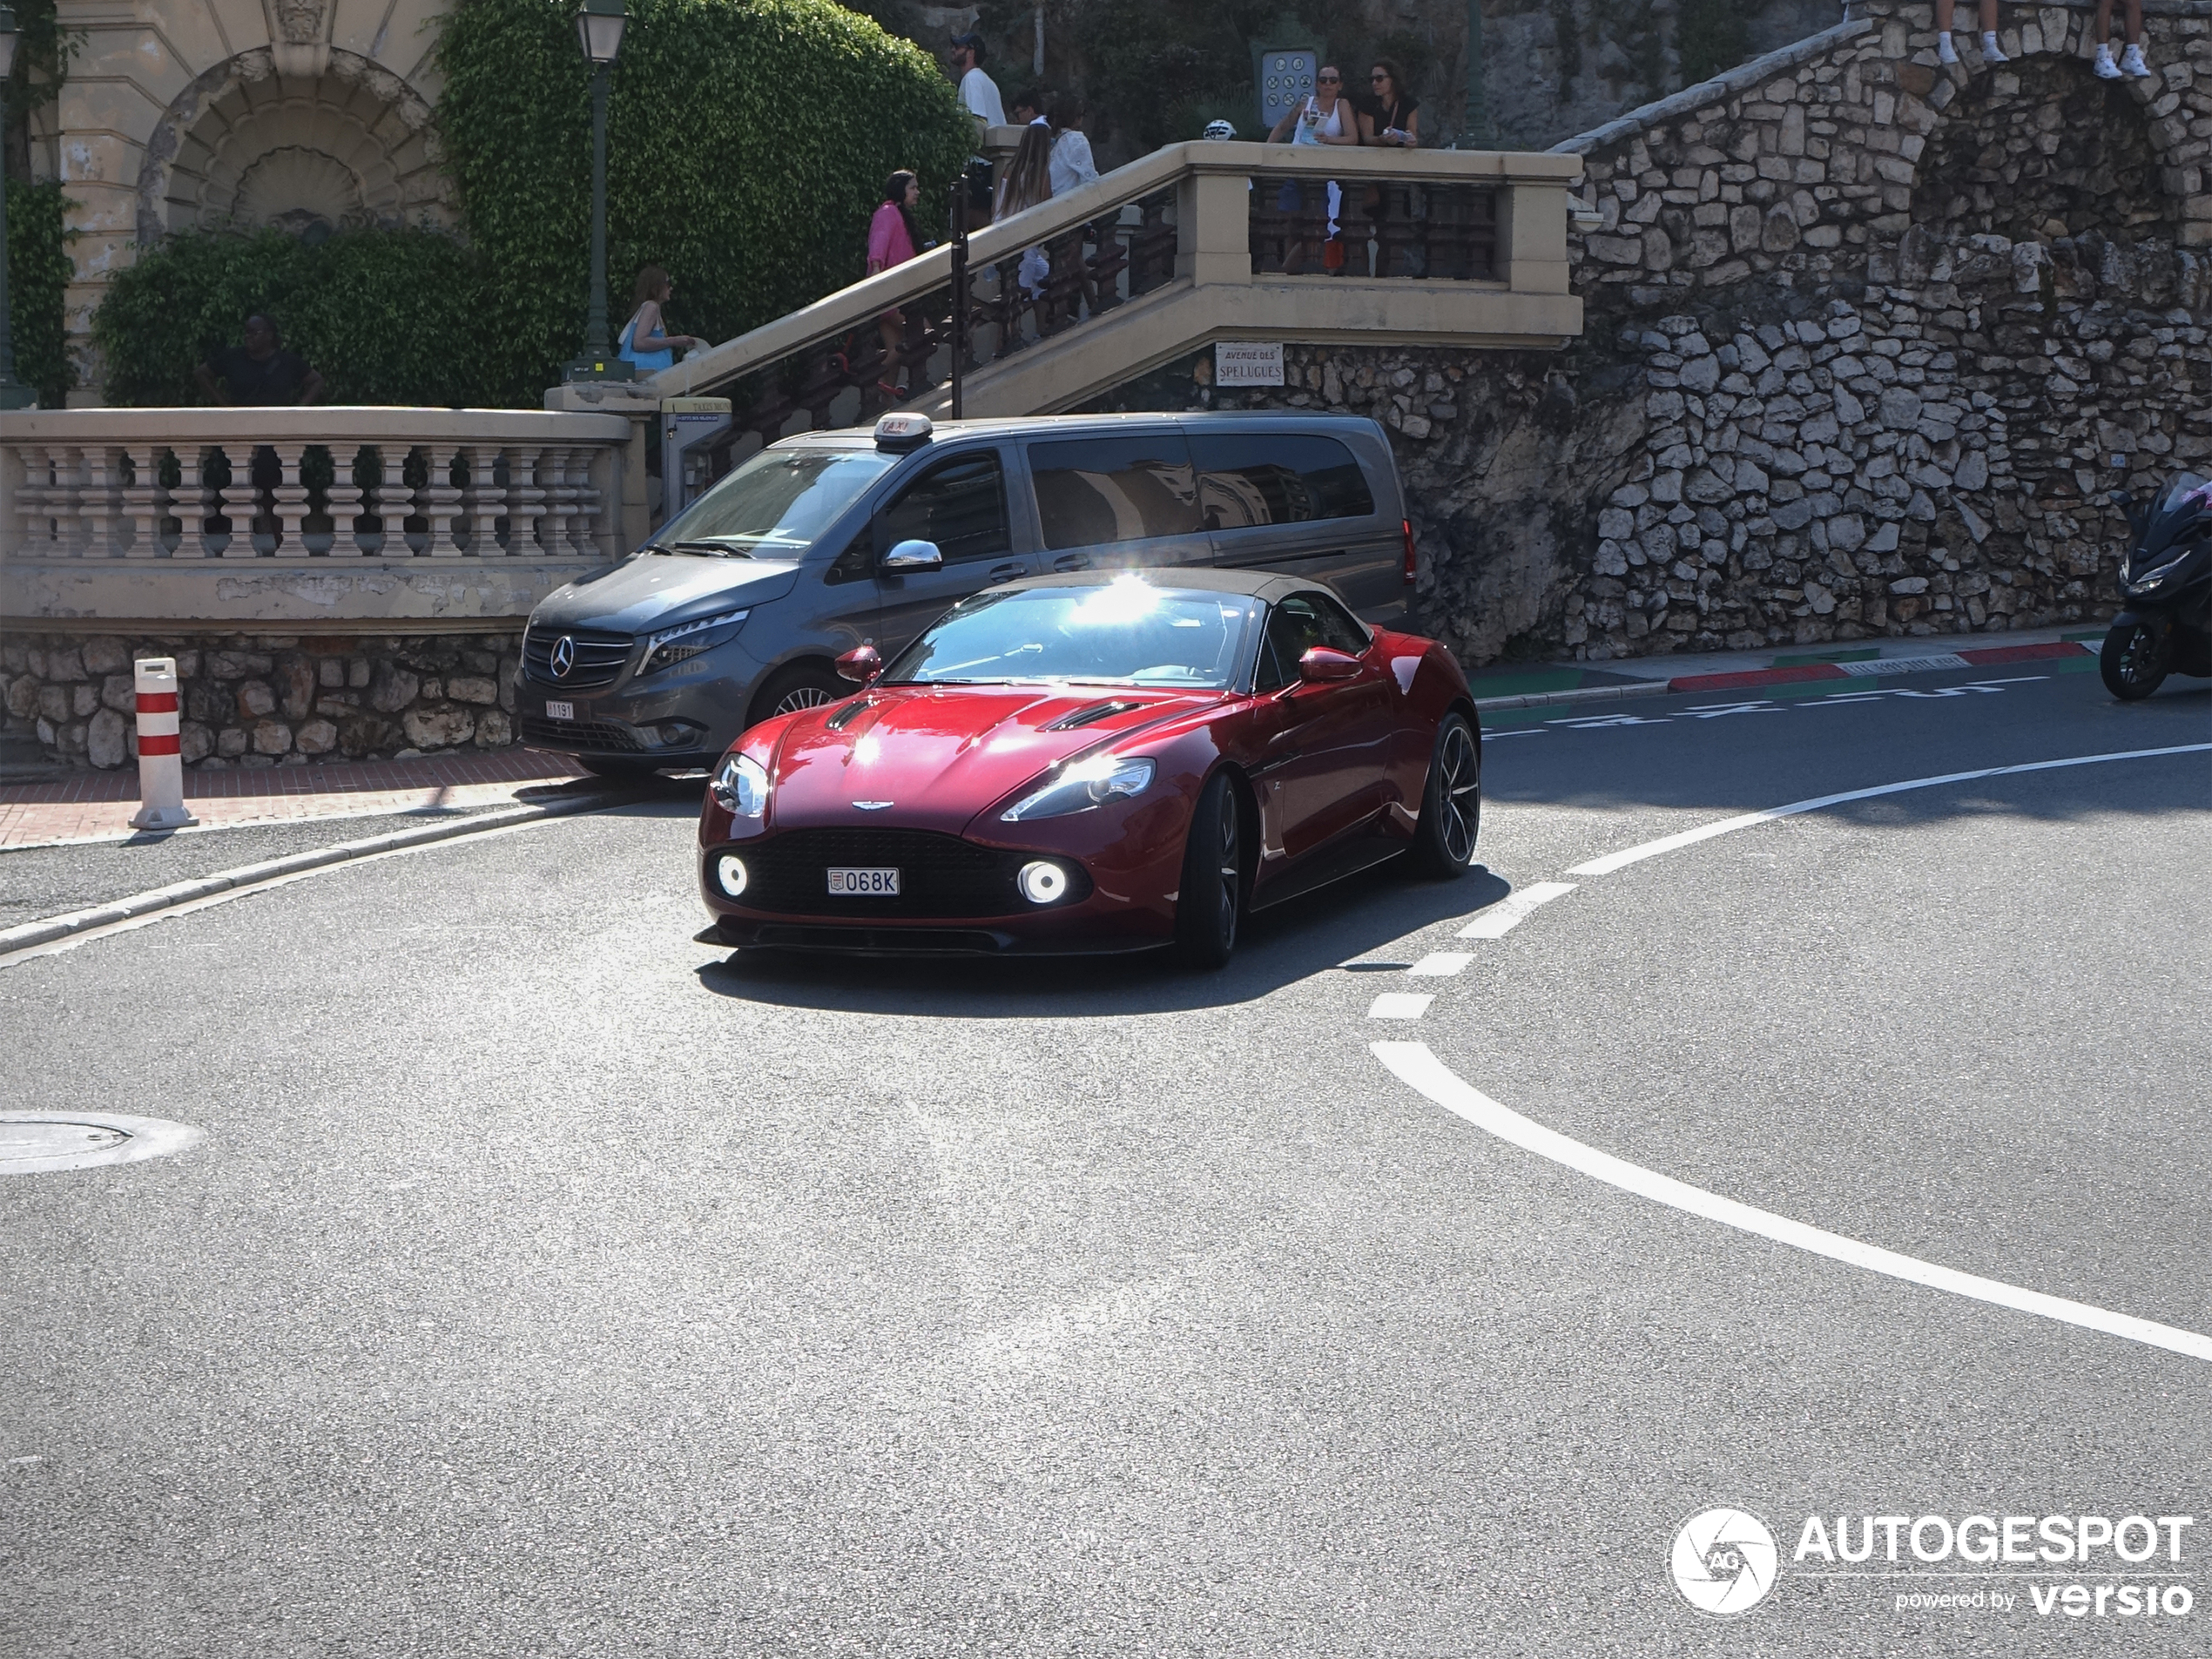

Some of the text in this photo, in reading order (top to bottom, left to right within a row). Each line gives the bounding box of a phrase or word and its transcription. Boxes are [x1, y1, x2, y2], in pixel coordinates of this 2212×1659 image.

[1225, 351, 1275, 361] AVENUE DES
[1220, 366, 1282, 378] SPELUGUES
[881, 421, 909, 432] TAXI
[552, 703, 571, 718] 1191
[846, 872, 896, 892] 068K
